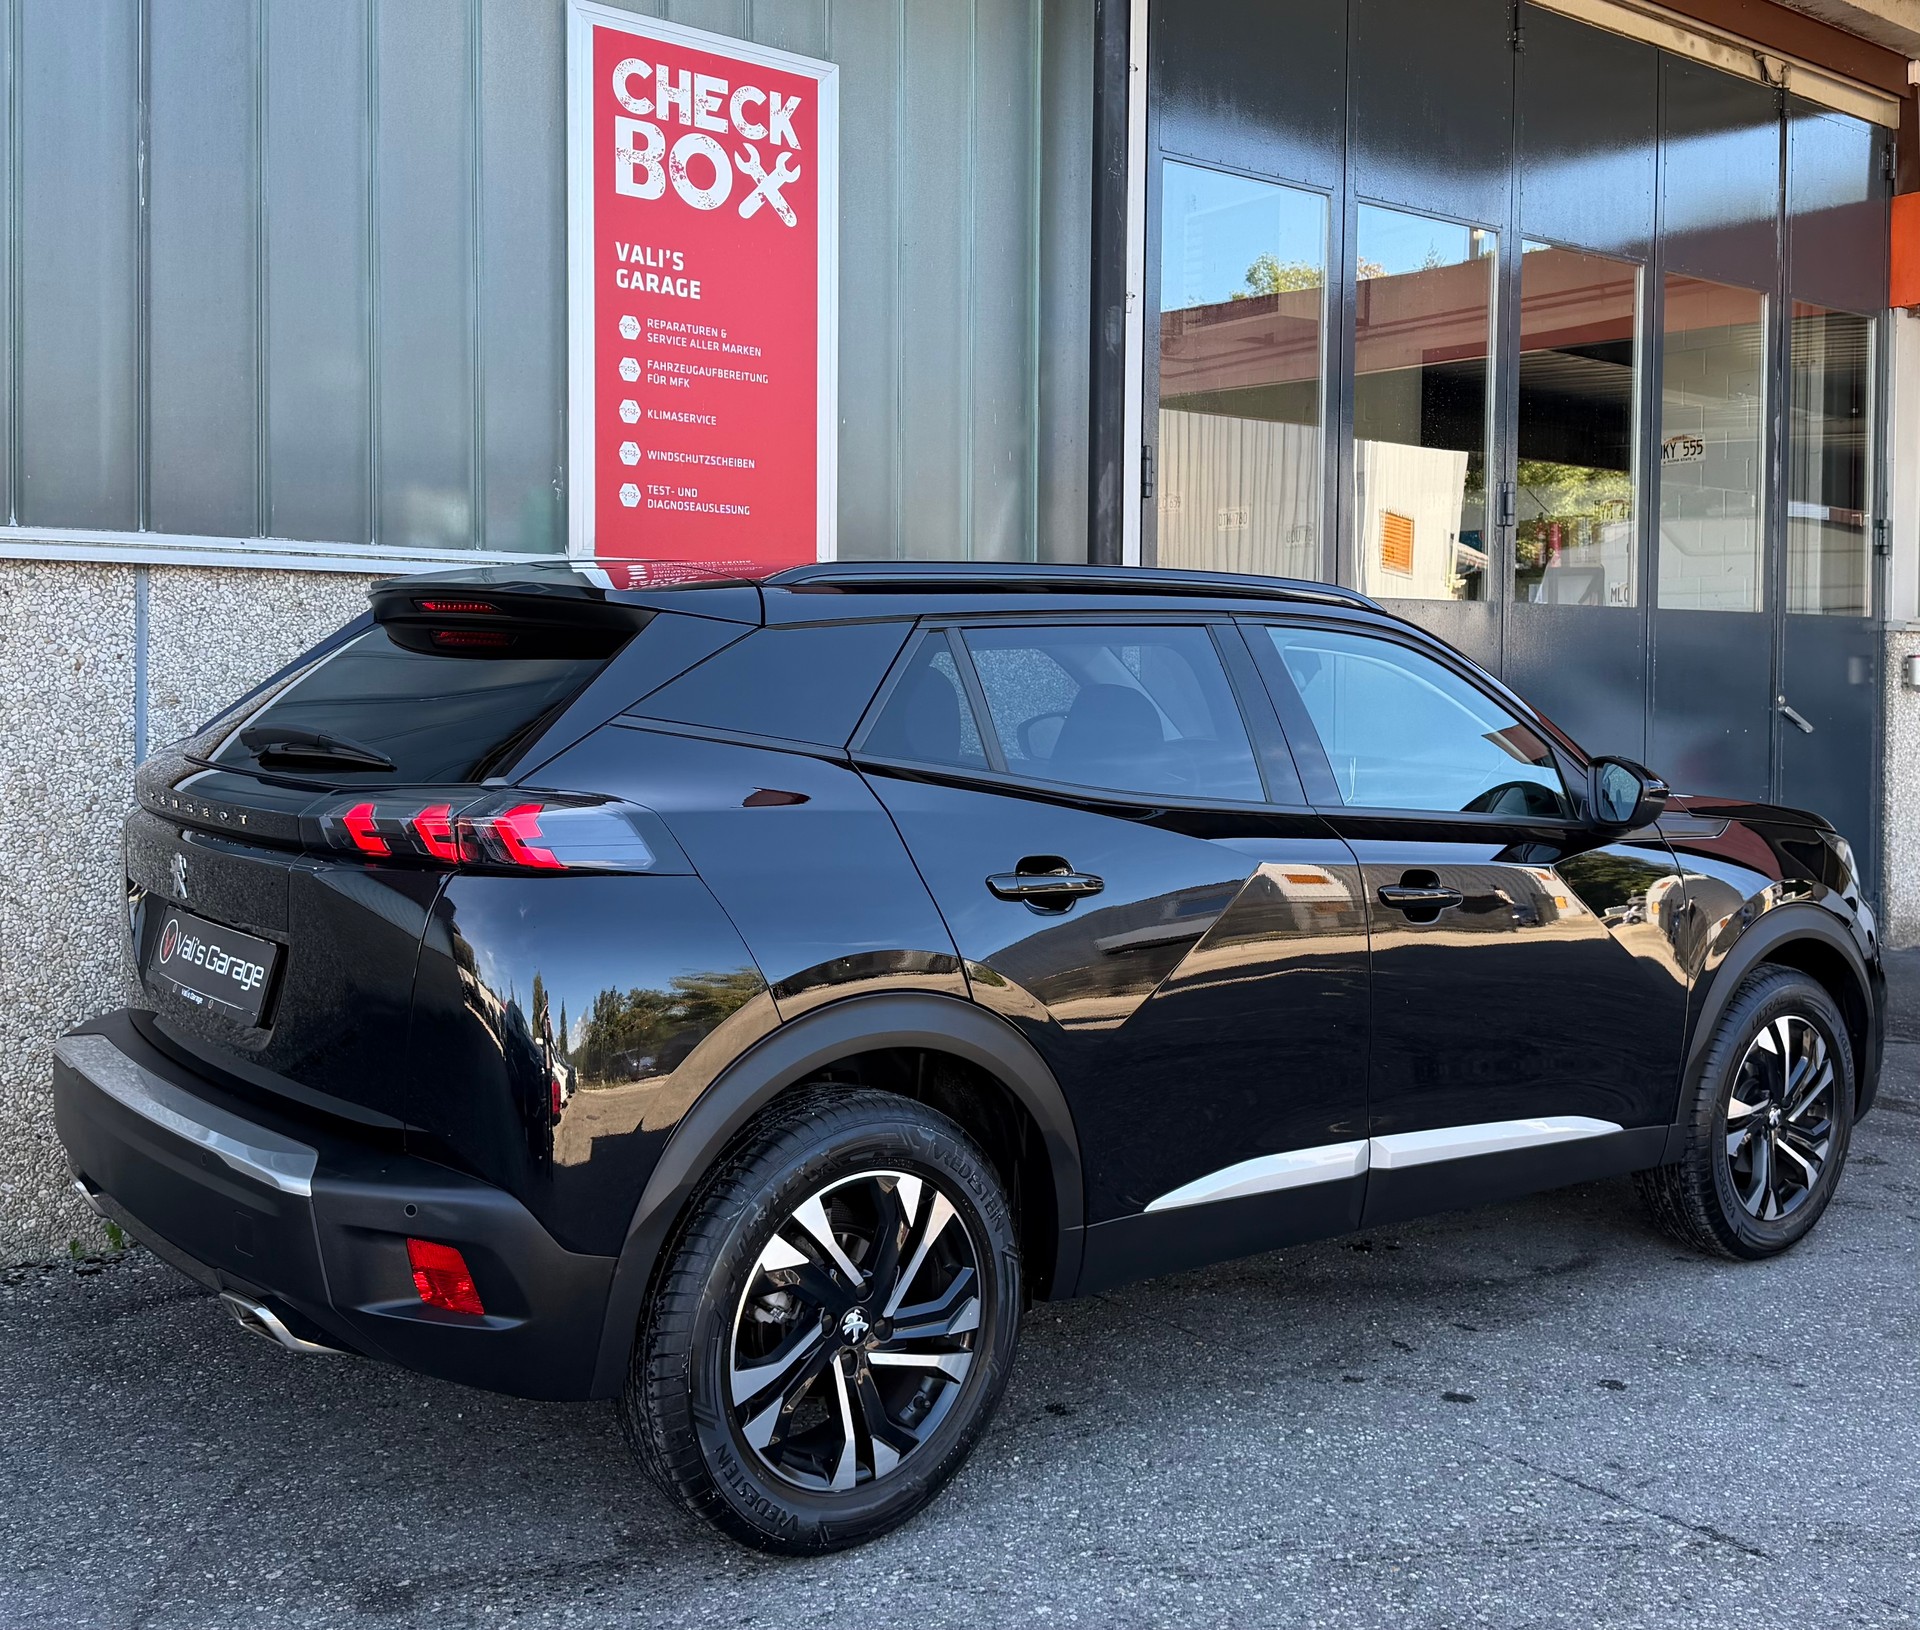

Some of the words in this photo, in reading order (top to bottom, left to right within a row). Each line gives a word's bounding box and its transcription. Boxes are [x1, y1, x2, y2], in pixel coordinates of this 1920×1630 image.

[612, 57, 802, 150] CHECK
[615, 241, 684, 271] VALI'S
[616, 268, 701, 300] GARAGE
[647, 318, 718, 338] REPARATUREN
[720, 328, 727, 339] &
[647, 333, 687, 348] SERVICE
[690, 338, 720, 352] ALLER
[722, 343, 762, 357] MARKEN
[647, 360, 769, 384] FAHRZEUGAUFBEREITUNG
[647, 373, 667, 386] FÜR
[670, 377, 690, 388] MFK
[647, 409, 717, 426] KLIMASERVICE
[647, 450, 755, 469] WINDSCHUTZSCHEIBEN
[1660, 442, 1677, 460] KY
[1683, 439, 1704, 457] 555
[647, 485, 675, 496] TEST-
[677, 487, 698, 498] UND
[647, 499, 750, 515] DIAGNOSEAUSLESUNG
[177, 931, 206, 965] Vali's
[205, 945, 265, 991] Garage
